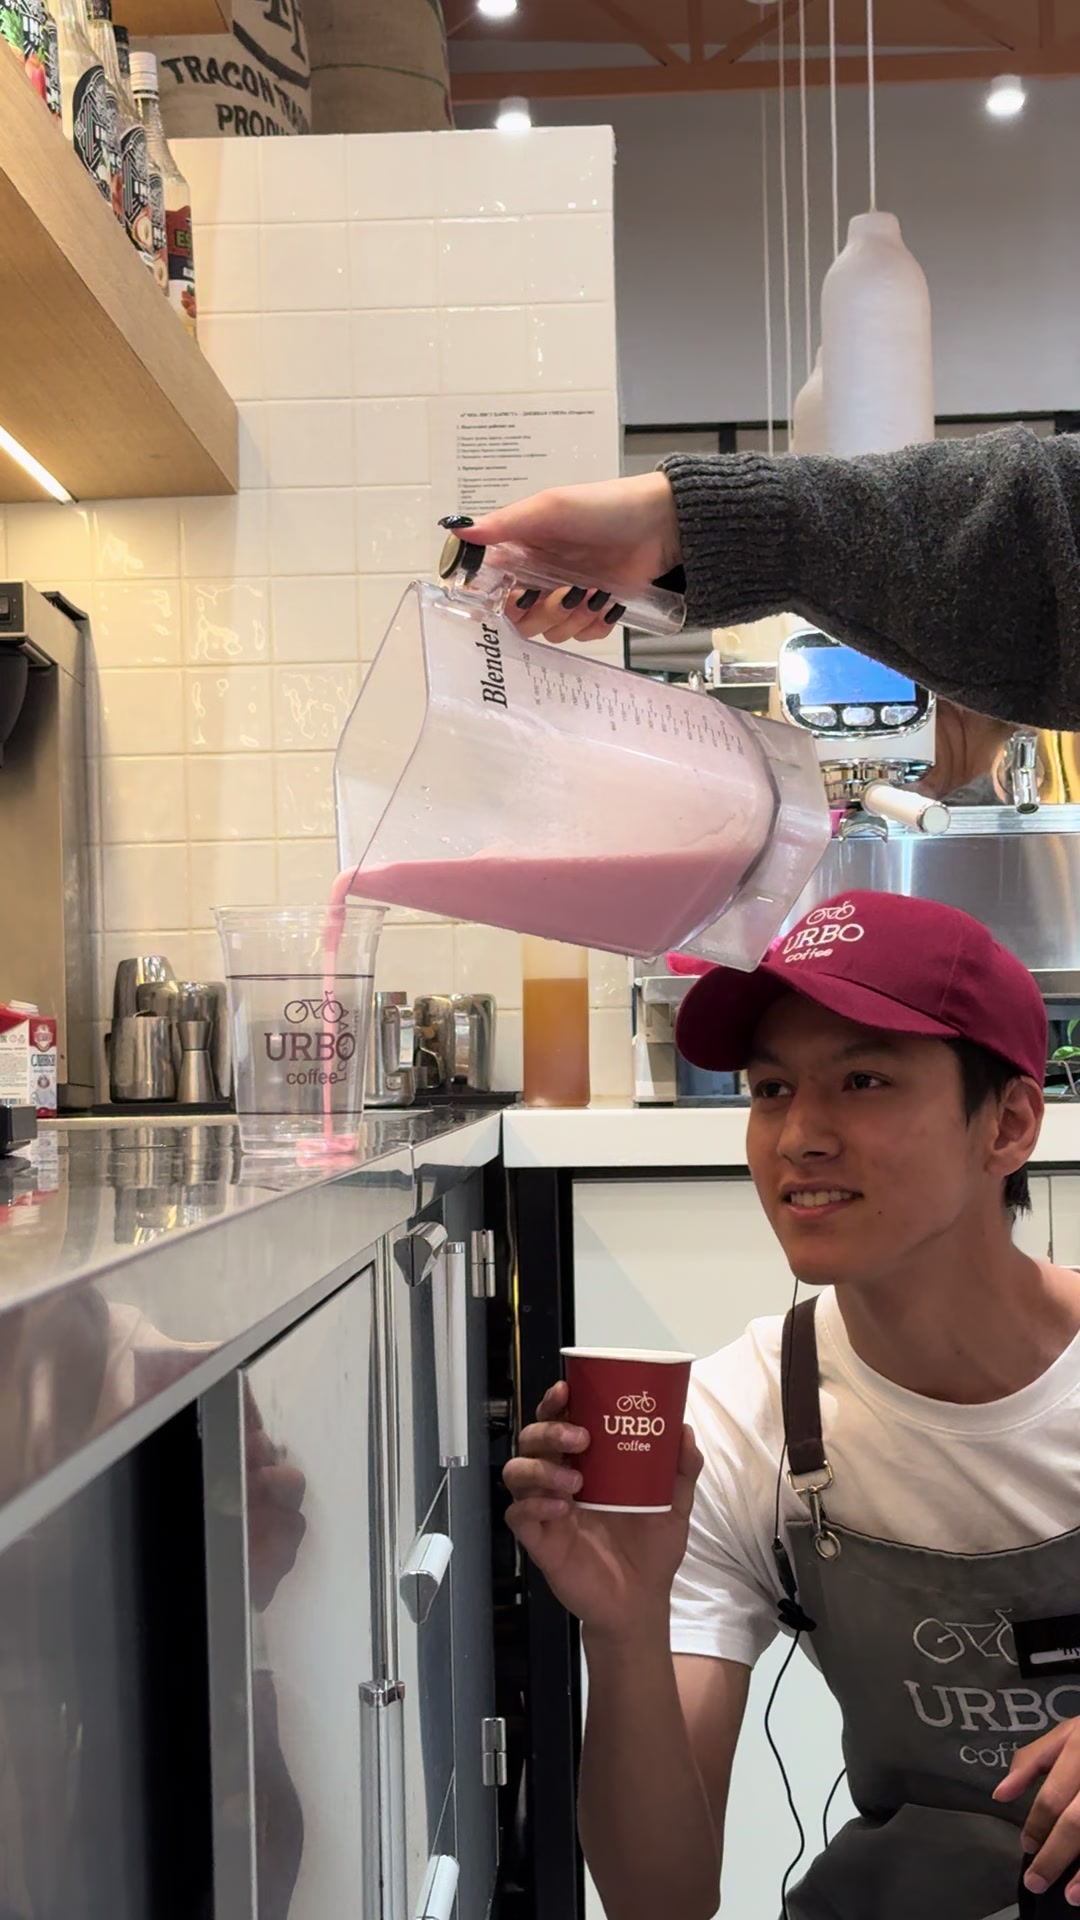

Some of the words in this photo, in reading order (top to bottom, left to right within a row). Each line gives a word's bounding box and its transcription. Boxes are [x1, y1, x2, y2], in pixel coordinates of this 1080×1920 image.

[475, 623, 508, 709] Blender
[782, 923, 865, 955] URBO
[785, 947, 833, 963] coffee
[263, 1032, 356, 1062] URBO
[286, 1068, 338, 1085] coffee
[603, 1415, 665, 1436] URBO
[617, 1440, 651, 1452] coffee
[959, 1741, 1020, 1768] cof
